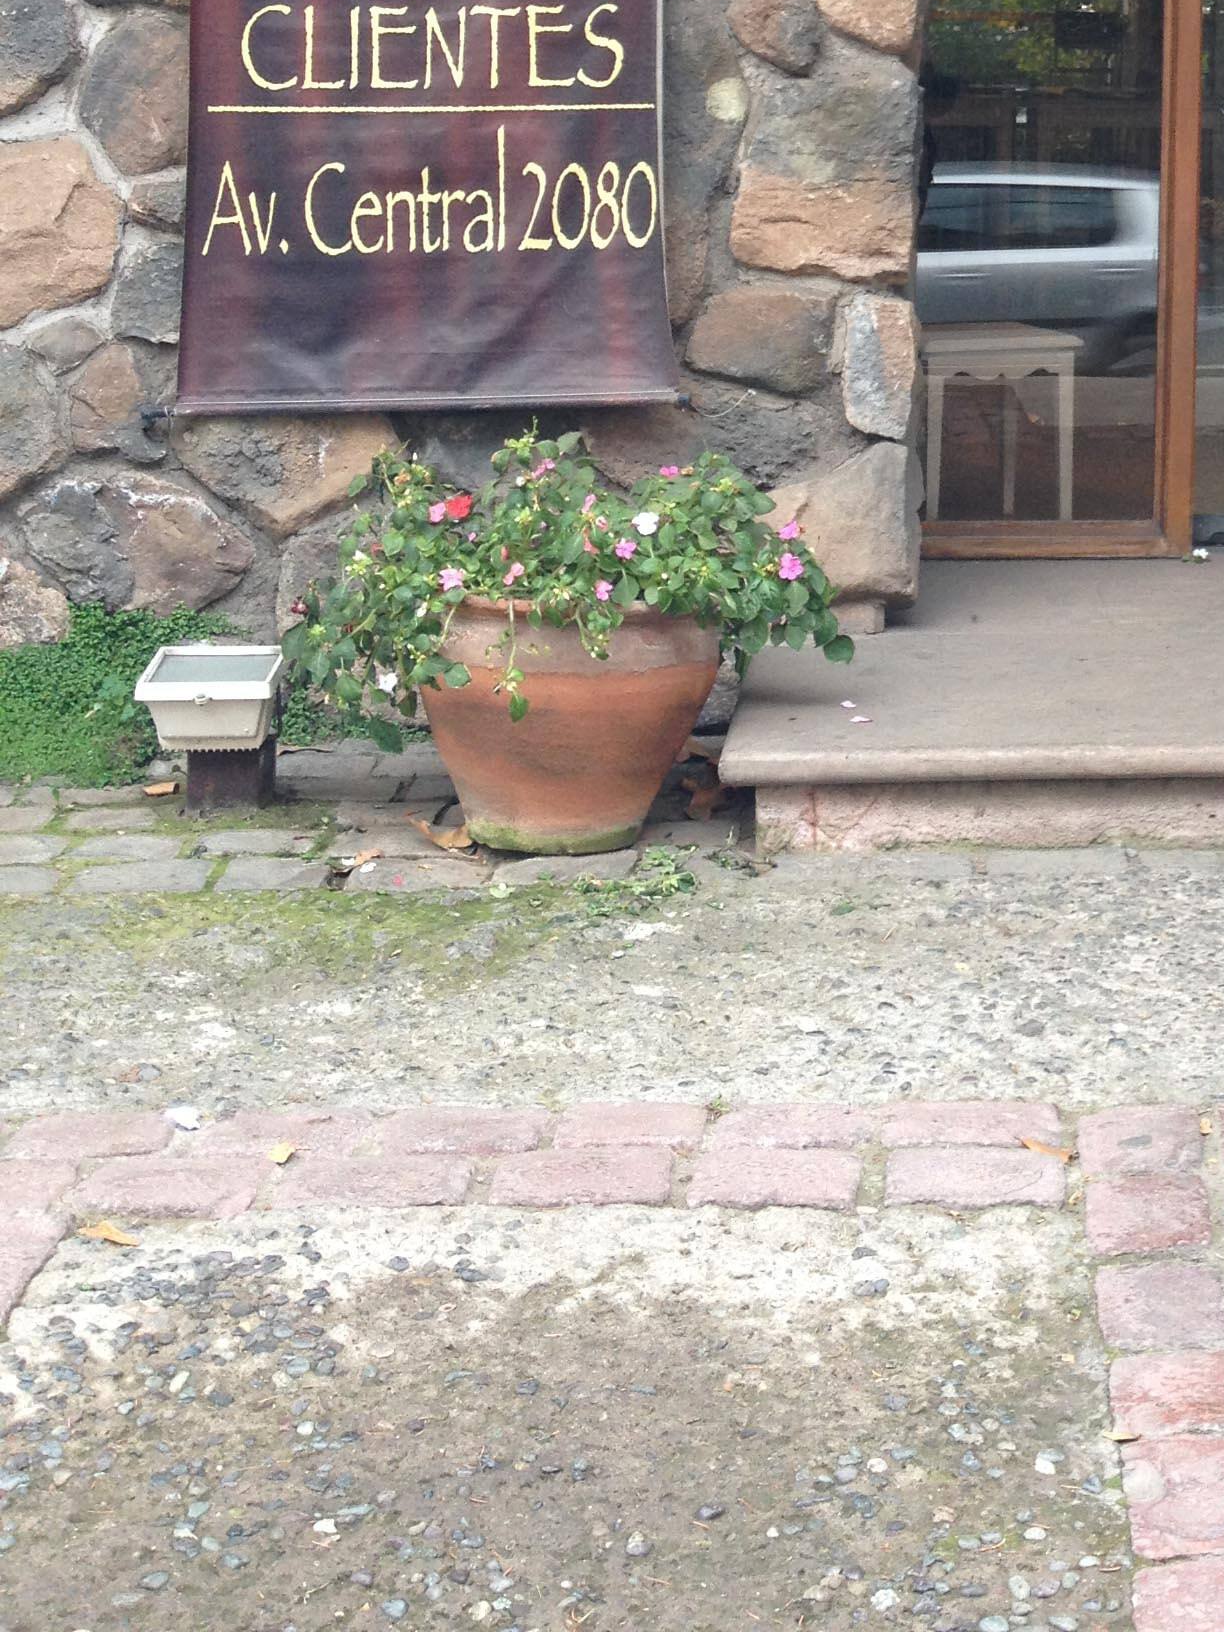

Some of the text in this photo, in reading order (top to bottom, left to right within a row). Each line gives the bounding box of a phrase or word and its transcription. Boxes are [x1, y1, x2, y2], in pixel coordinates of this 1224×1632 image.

[241, 3, 625, 91] CLIENTES
[202, 124, 658, 256] Av. Central 2080
